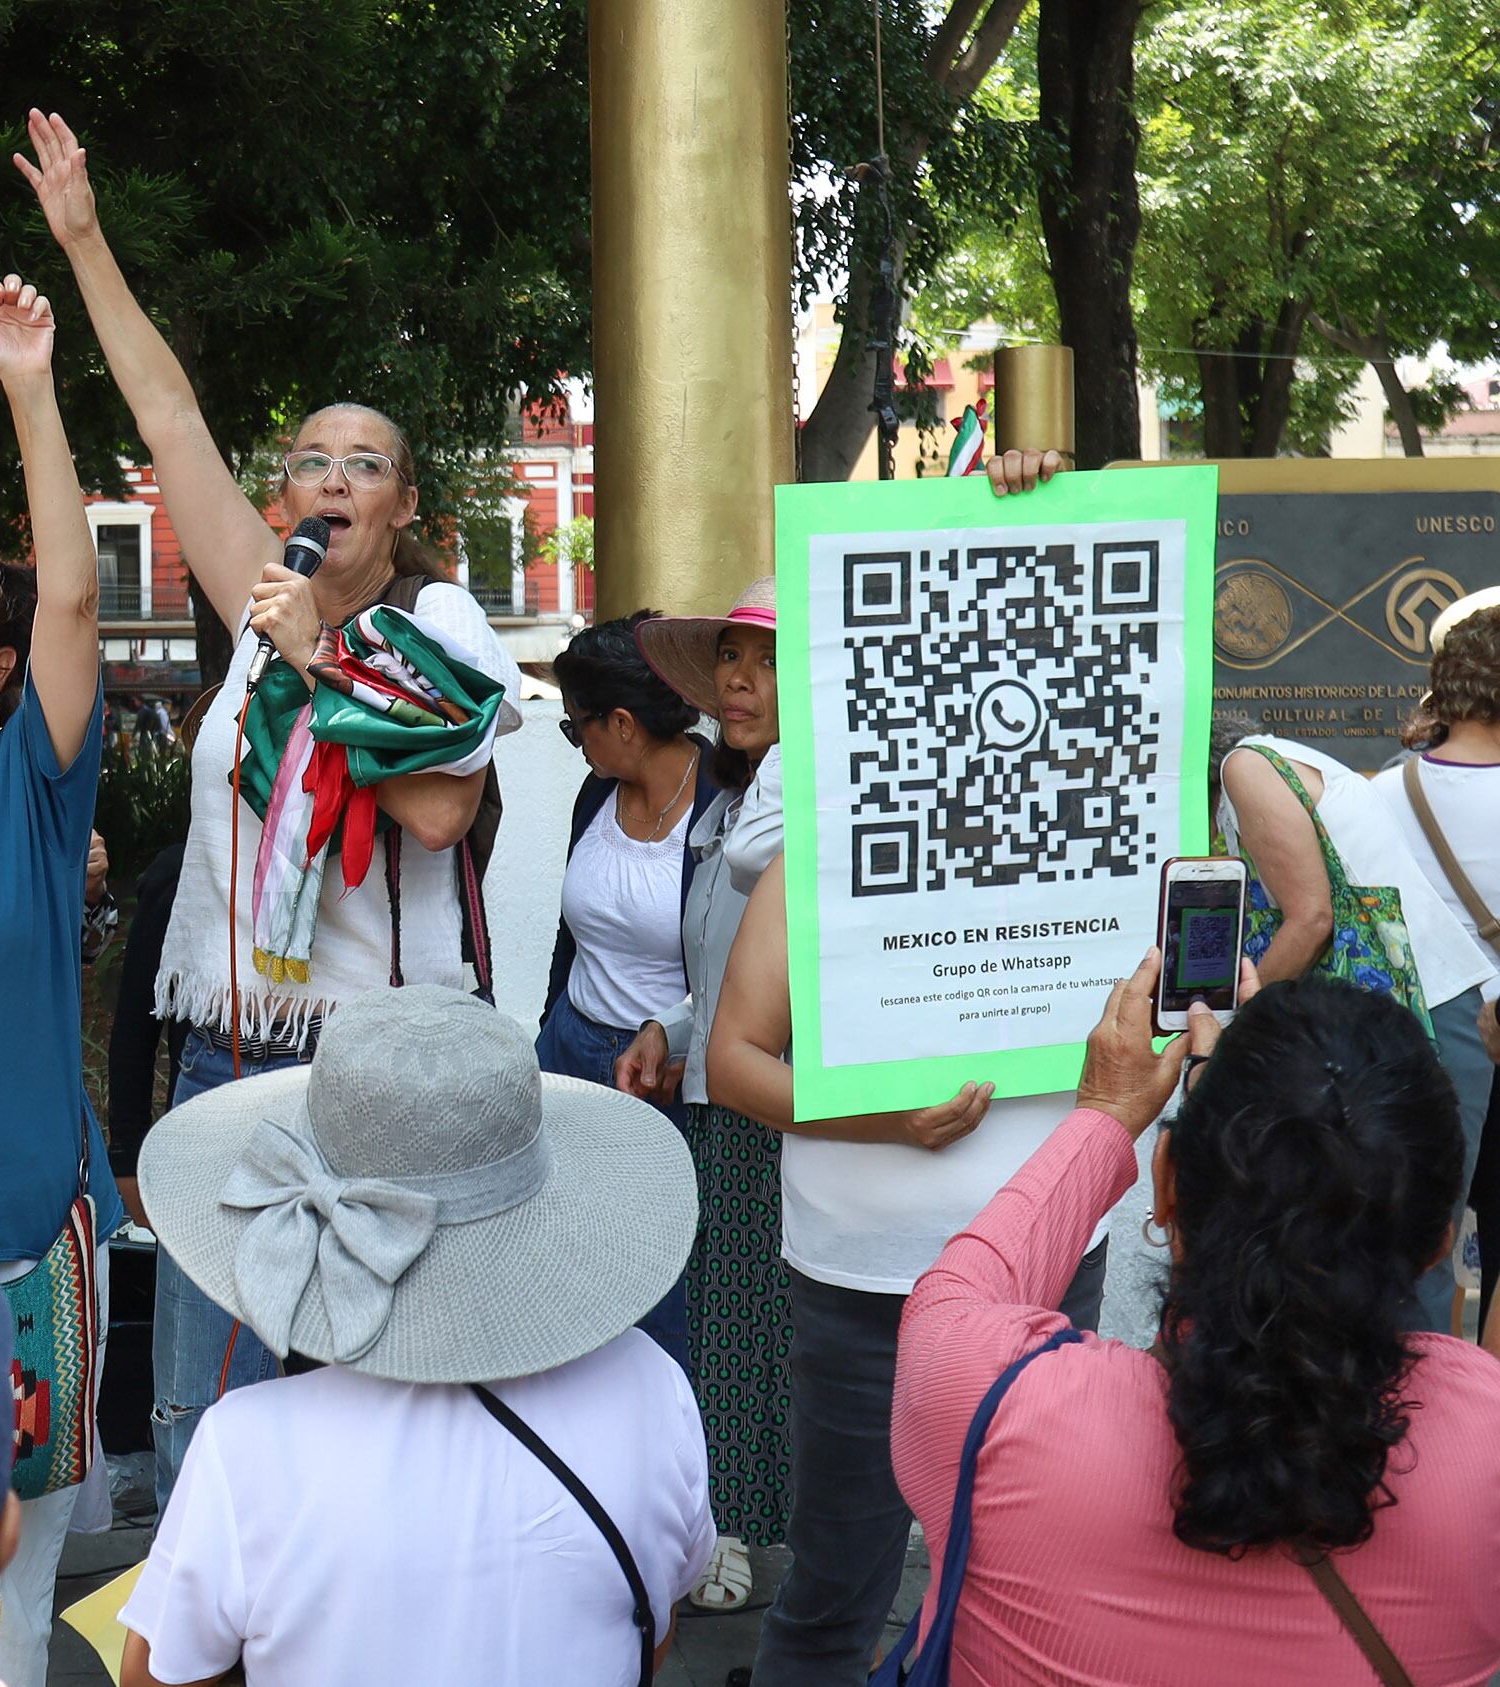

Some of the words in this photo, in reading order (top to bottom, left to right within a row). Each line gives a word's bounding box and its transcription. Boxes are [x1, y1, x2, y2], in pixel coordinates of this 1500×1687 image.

[1217, 519, 1249, 536] ICO
[1416, 516, 1495, 533] UNESCO
[1294, 685, 1365, 699] HISTORICOS
[1368, 685, 1385, 698] DE
[1262, 708, 1348, 721] CULTURAL
[1364, 709, 1383, 721] DE
[883, 931, 957, 951] MEXICO
[963, 928, 988, 943] EN
[996, 917, 1120, 941] RESISTENCIA
[933, 964, 976, 978] Grupo
[980, 960, 997, 973] de
[1001, 956, 1071, 971] Whatsapp
[880, 996, 921, 1008] (escanea
[923, 993, 942, 1003] este
[944, 990, 974, 1000] codigo
[977, 988, 990, 998] QR
[993, 987, 1009, 996] con
[1010, 985, 1018, 994] la
[1021, 984, 1054, 993] camara
[1056, 981, 1067, 990] de
[1069, 981, 1079, 989] tu
[959, 1012, 980, 1022] para
[982, 1008, 1009, 1018] unirte
[1011, 1006, 1019, 1015] al
[1021, 1003, 1051, 1016] grupo)
